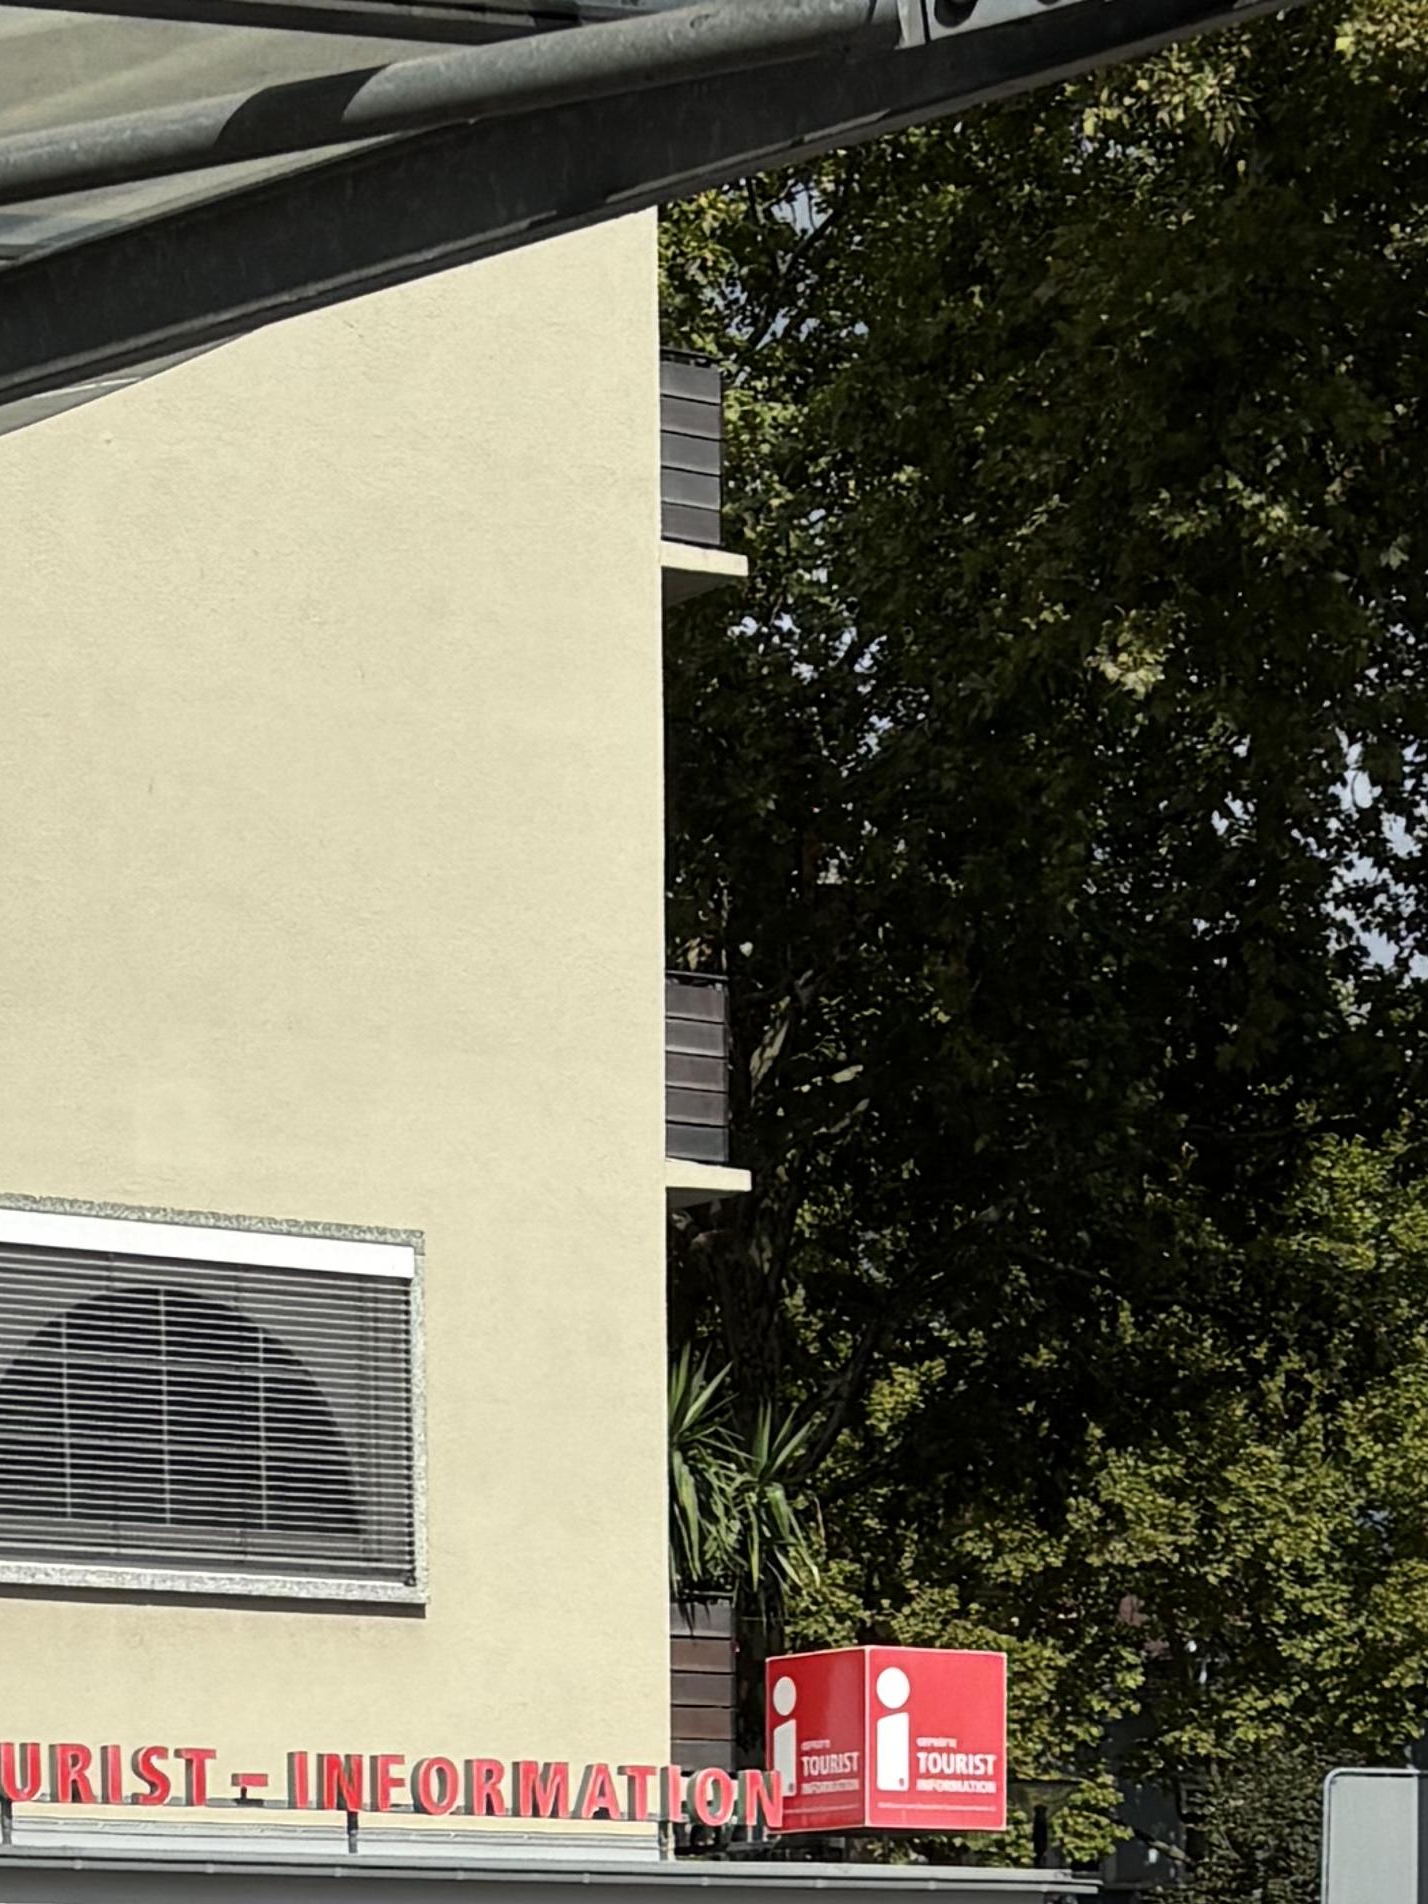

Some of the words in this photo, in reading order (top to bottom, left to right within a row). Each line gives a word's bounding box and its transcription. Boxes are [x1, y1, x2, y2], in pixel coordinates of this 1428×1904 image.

[801, 1752, 860, 1777] TOURIST
[916, 1752, 997, 1776] TOURIST
[916, 1778, 997, 1795] INFORMATION
